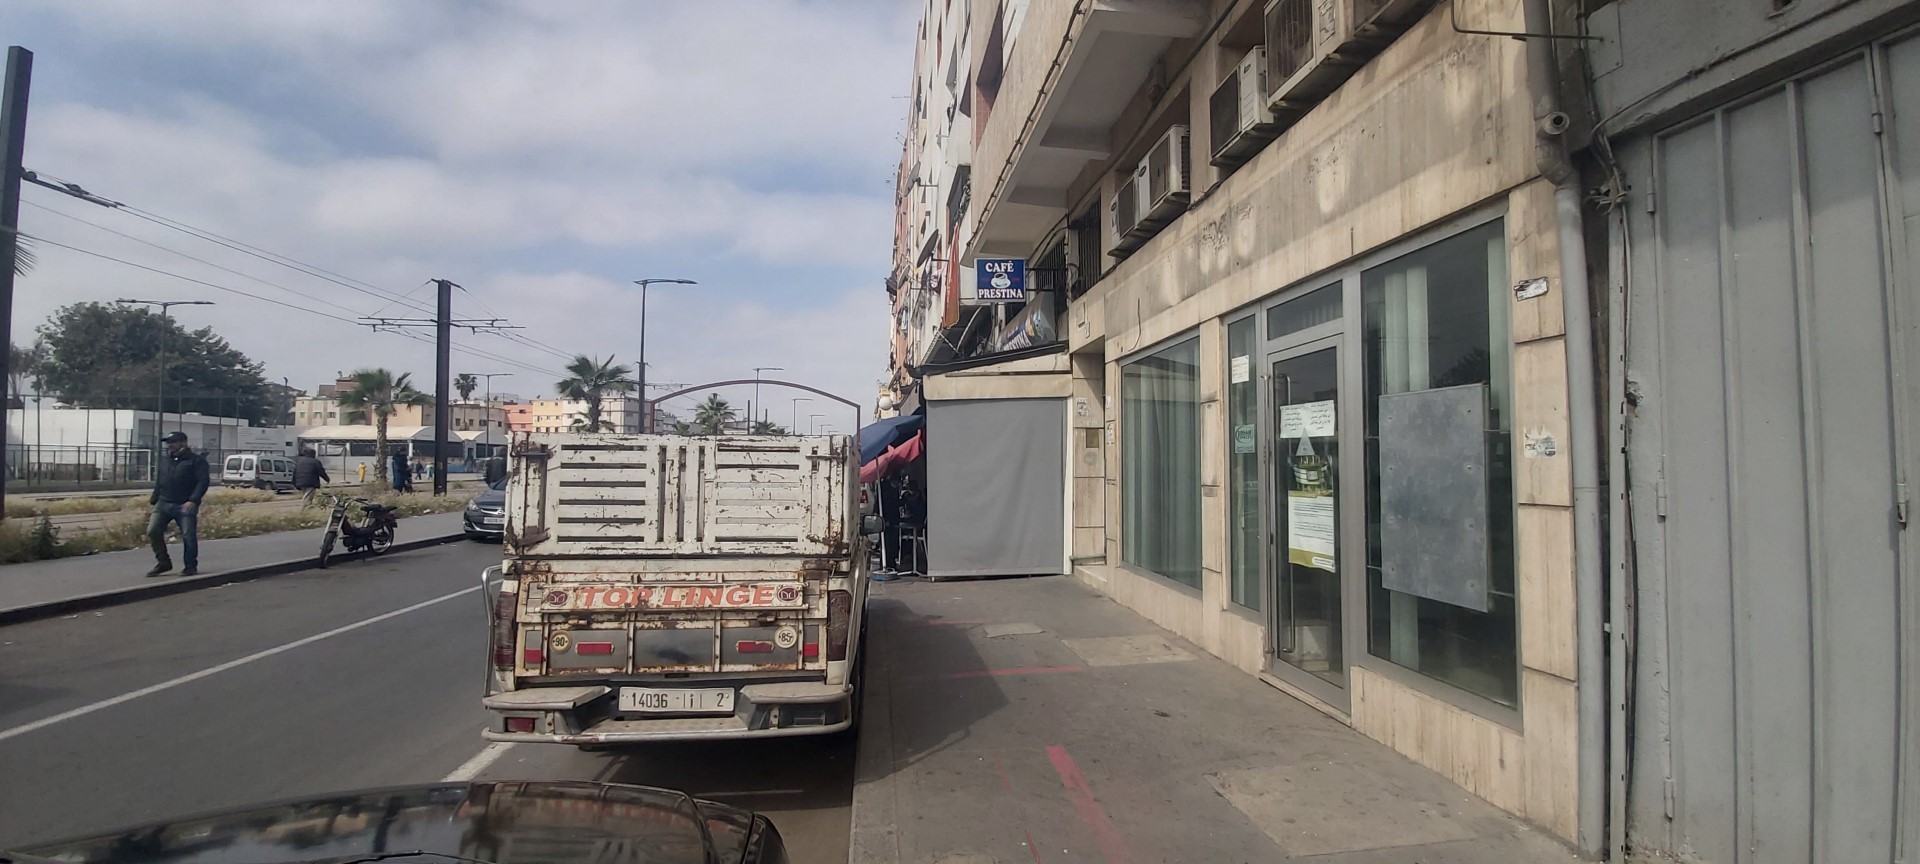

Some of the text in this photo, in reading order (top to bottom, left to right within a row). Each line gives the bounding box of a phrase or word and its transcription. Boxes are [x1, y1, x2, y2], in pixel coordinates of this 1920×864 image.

[985, 260, 1015, 273] CAFÉ
[978, 288, 1023, 299] PRESTINA
[580, 585, 775, 607] TOP LINGE
[555, 636, 565, 647] 90
[632, 692, 668, 708] 14036
[717, 692, 724, 708] 2
